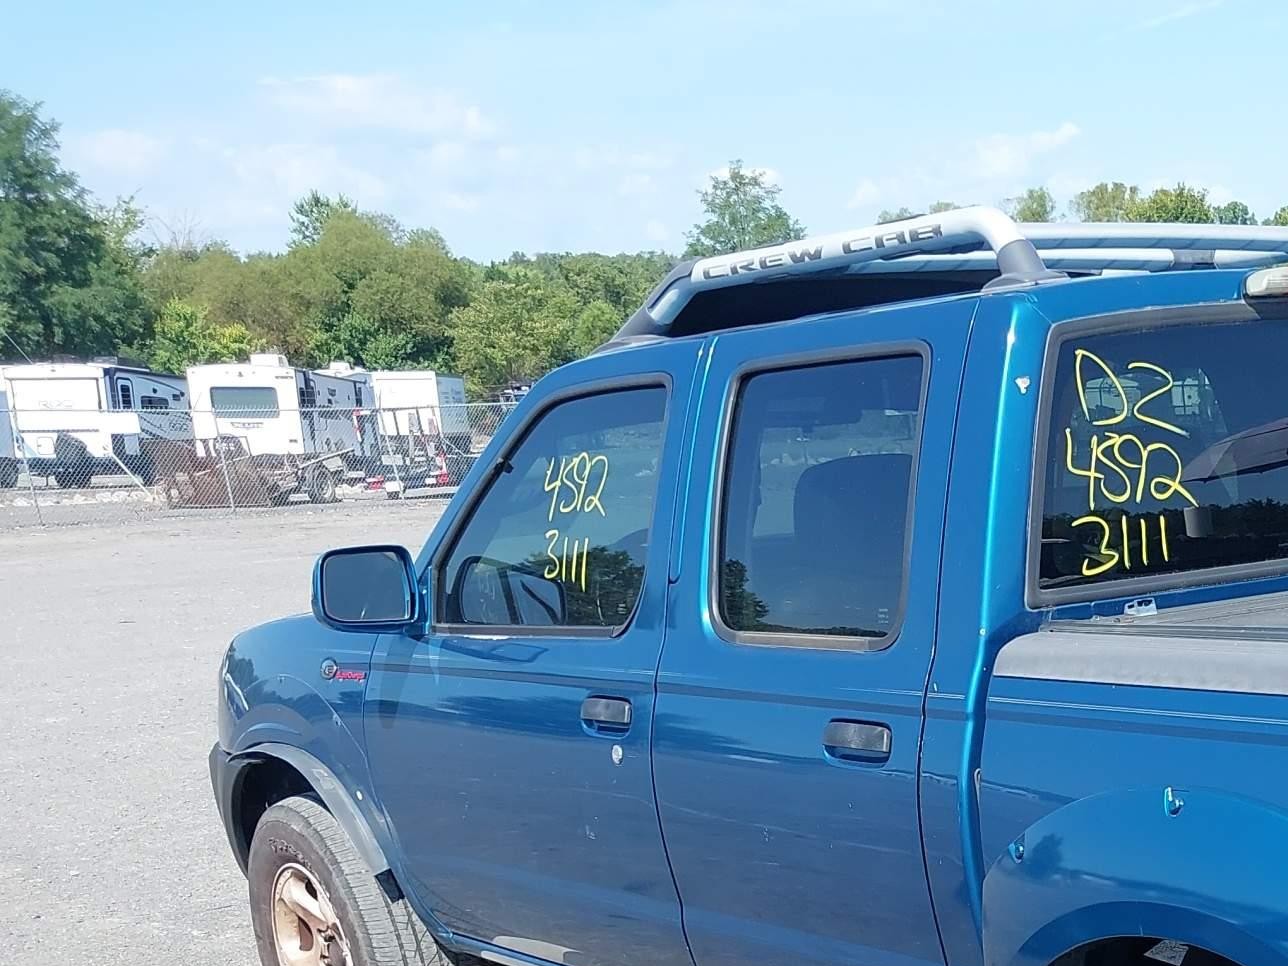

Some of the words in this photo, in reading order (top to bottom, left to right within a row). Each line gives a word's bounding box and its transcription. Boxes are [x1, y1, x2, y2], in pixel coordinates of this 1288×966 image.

[703, 245, 823, 280] CREW
[842, 223, 943, 254] CAB
[544, 452, 608, 521] 4592
[1065, 427, 1199, 511] 4592
[544, 529, 589, 592] 3111
[1072, 515, 1169, 576] 3111
